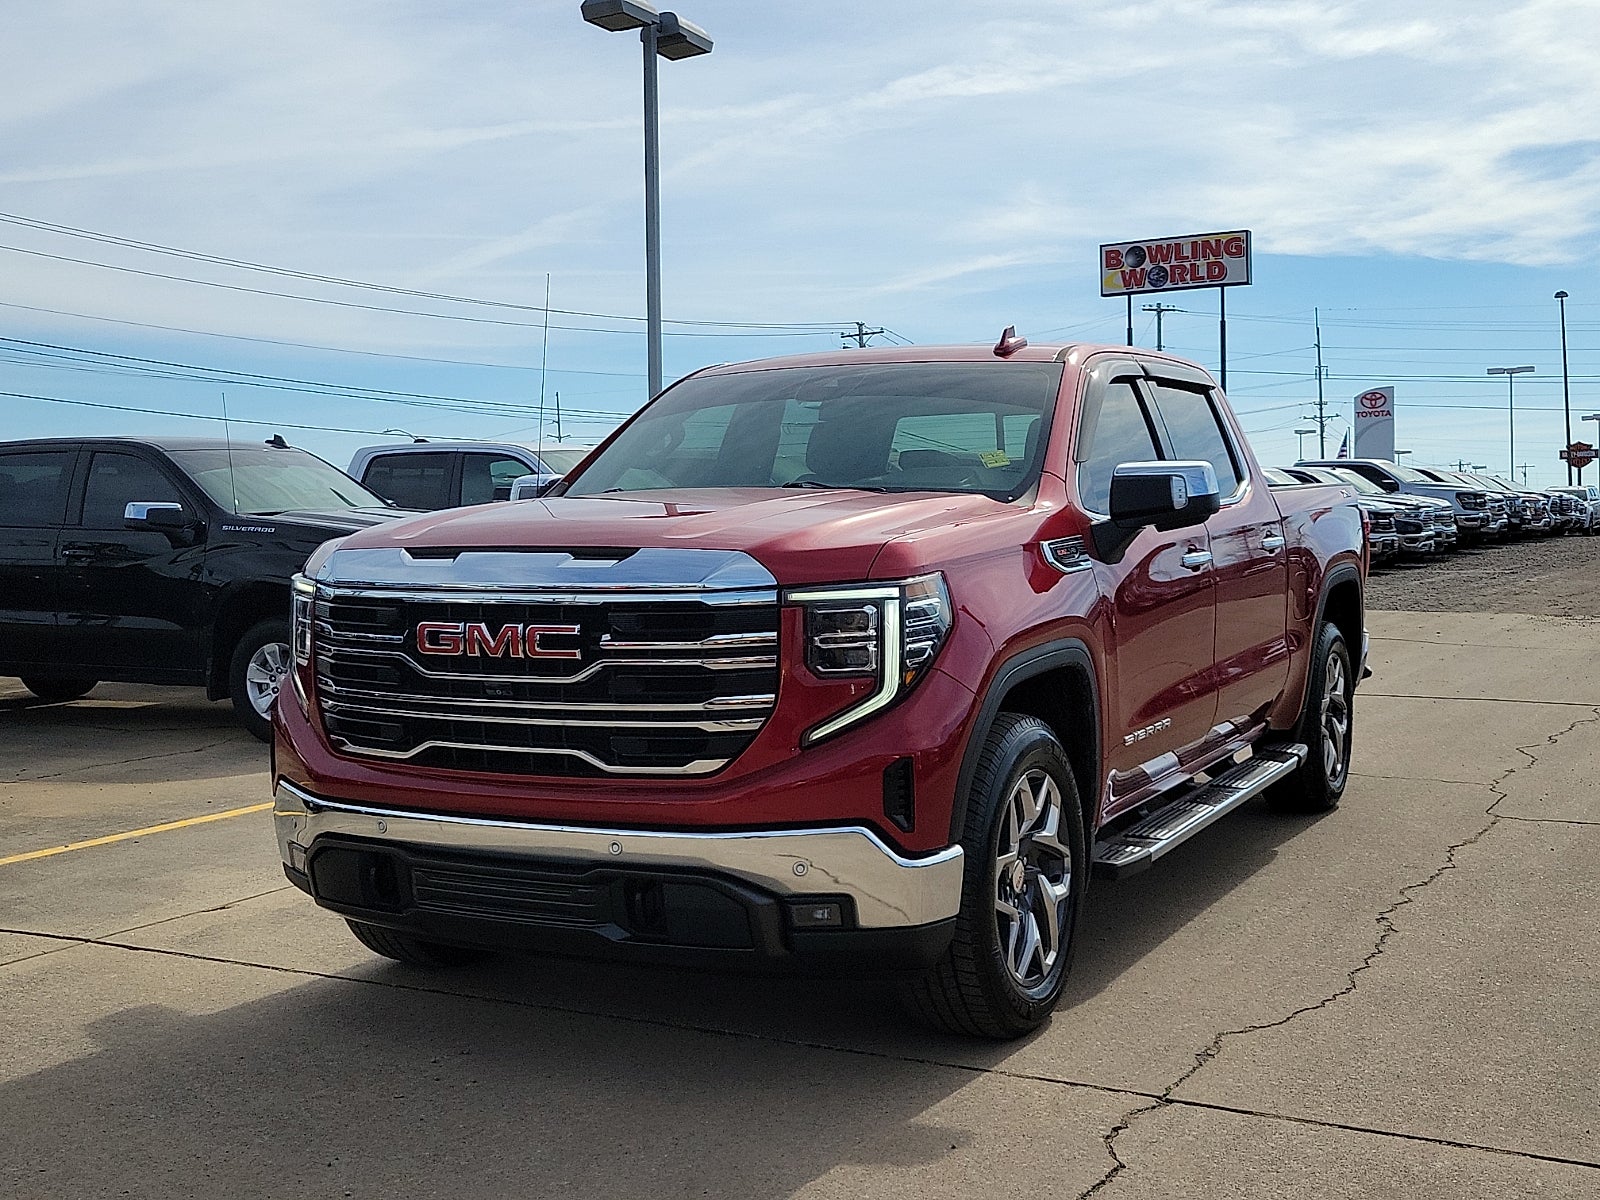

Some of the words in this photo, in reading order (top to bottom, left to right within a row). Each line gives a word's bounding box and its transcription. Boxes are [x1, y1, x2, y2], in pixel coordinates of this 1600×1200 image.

[1104, 236, 1245, 270] BOWLING
[1120, 260, 1227, 289] WORLD
[1355, 410, 1392, 418] TOYOTA
[221, 525, 276, 533] SILVERADO
[416, 621, 582, 661] GMC
[1123, 717, 1171, 746] SIERRA
